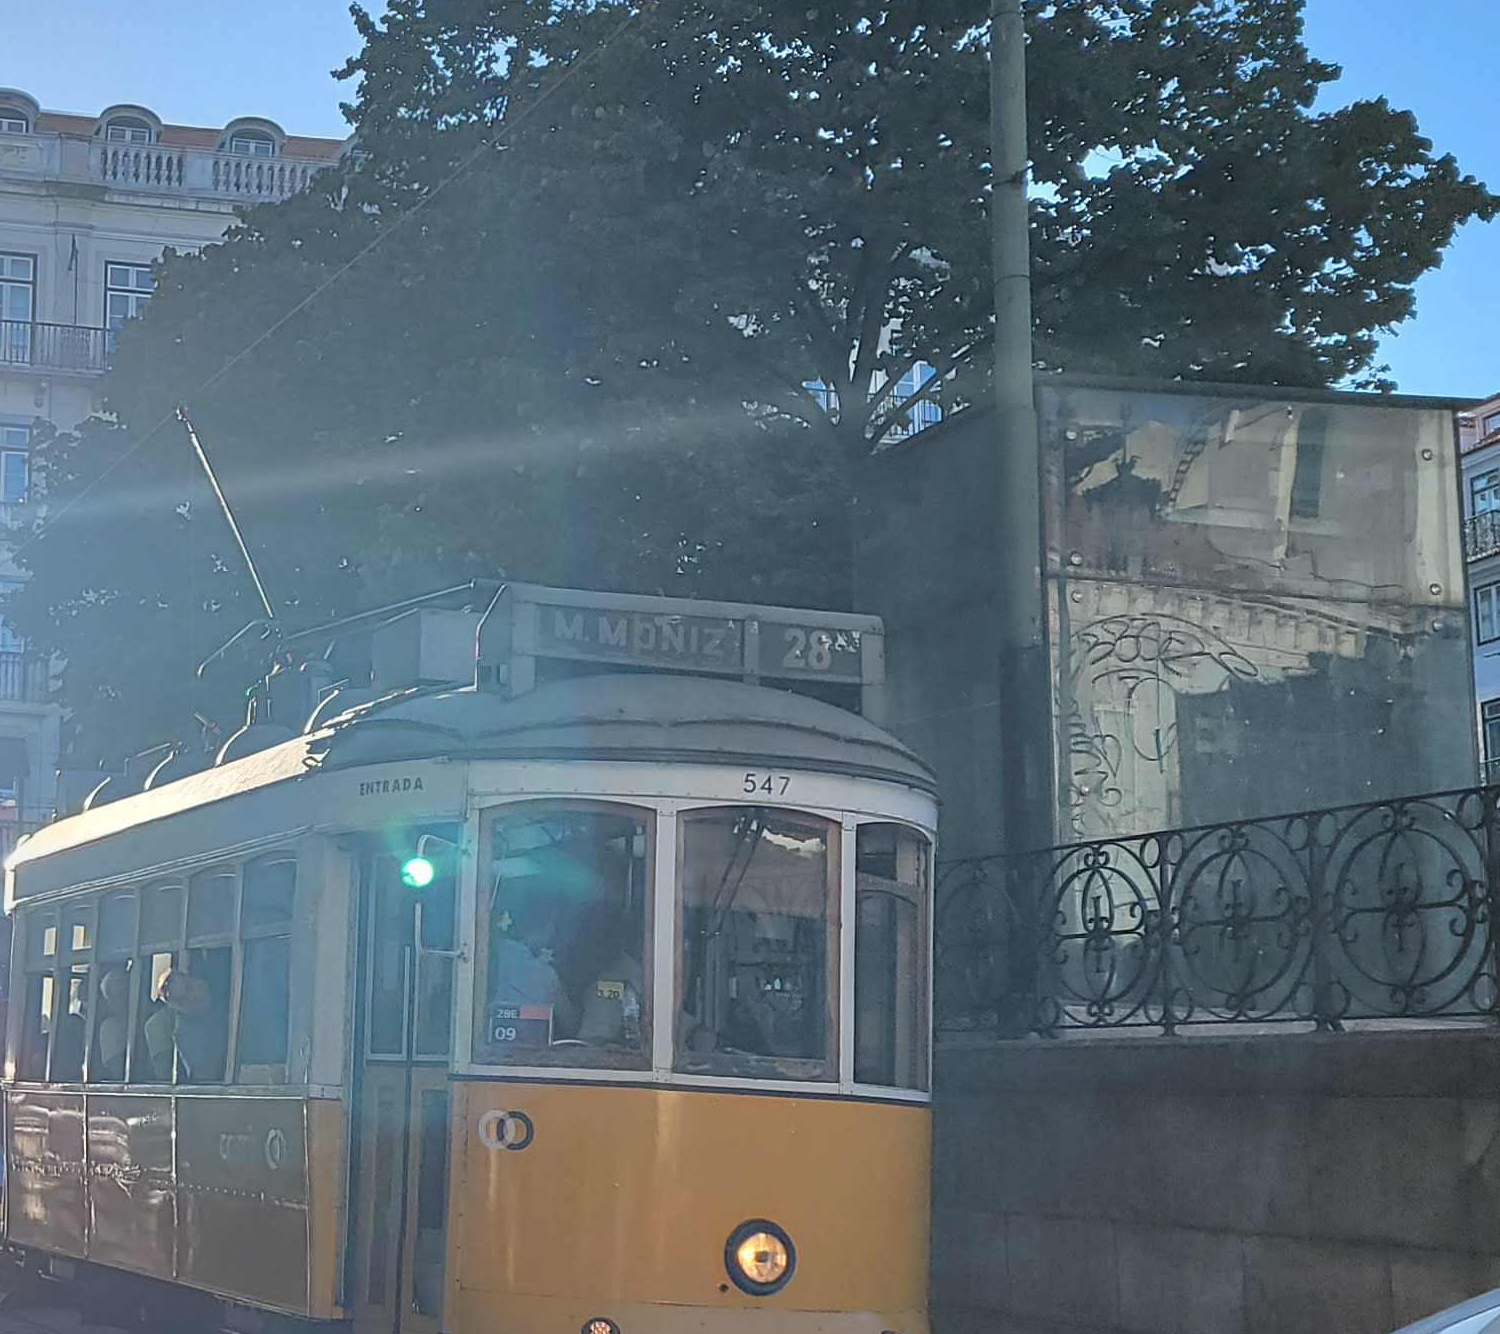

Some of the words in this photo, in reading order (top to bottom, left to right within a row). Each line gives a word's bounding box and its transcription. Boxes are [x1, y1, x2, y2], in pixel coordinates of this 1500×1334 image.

[555, 610, 589, 641] M.
[598, 616, 725, 654] MONIZ
[782, 628, 832, 670] 28
[359, 776, 424, 796] ENTRADA
[743, 773, 790, 796] 547
[496, 1008, 517, 1019] 28E
[494, 1026, 517, 1041] 09
